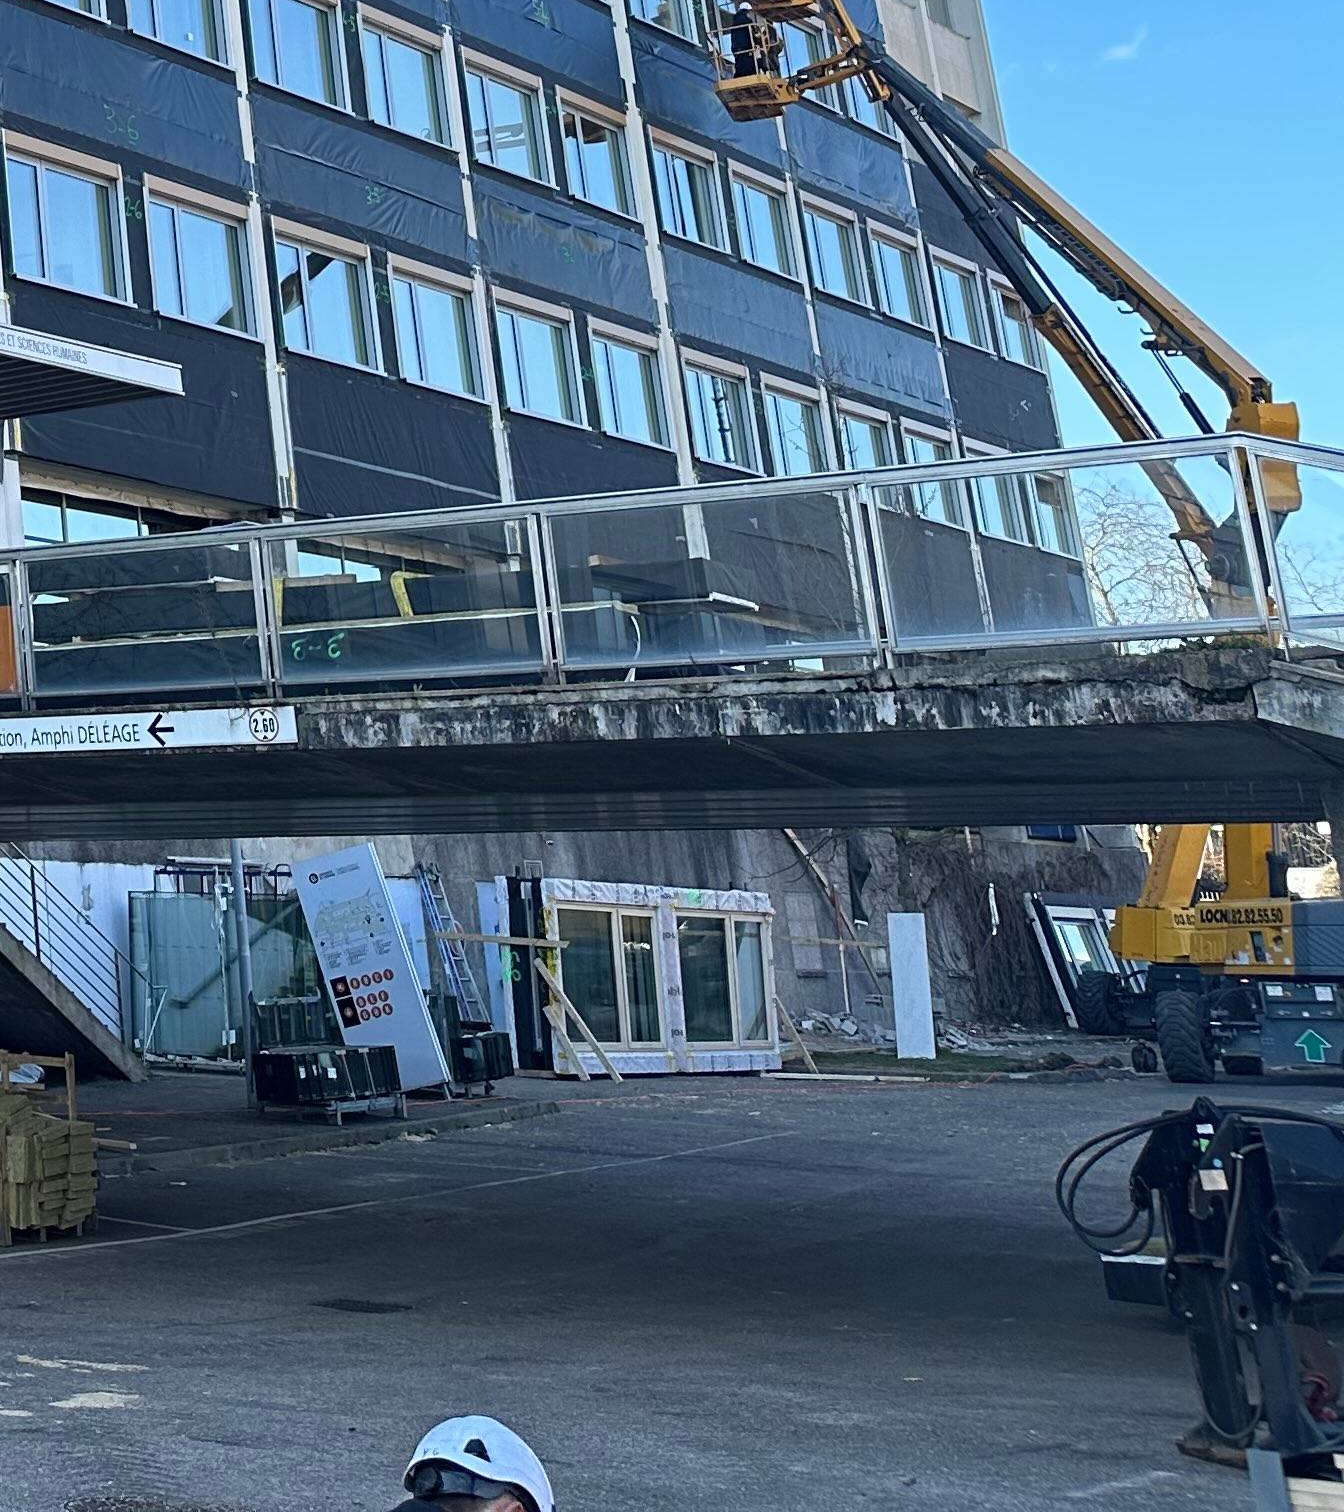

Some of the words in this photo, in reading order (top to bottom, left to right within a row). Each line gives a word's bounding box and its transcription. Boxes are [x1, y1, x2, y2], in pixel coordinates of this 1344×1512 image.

[7, 334, 15, 347] ET
[253, 716, 275, 734] 2.60
[31, 724, 73, 749] Amphi
[78, 720, 140, 744] DÉLÉAGE
